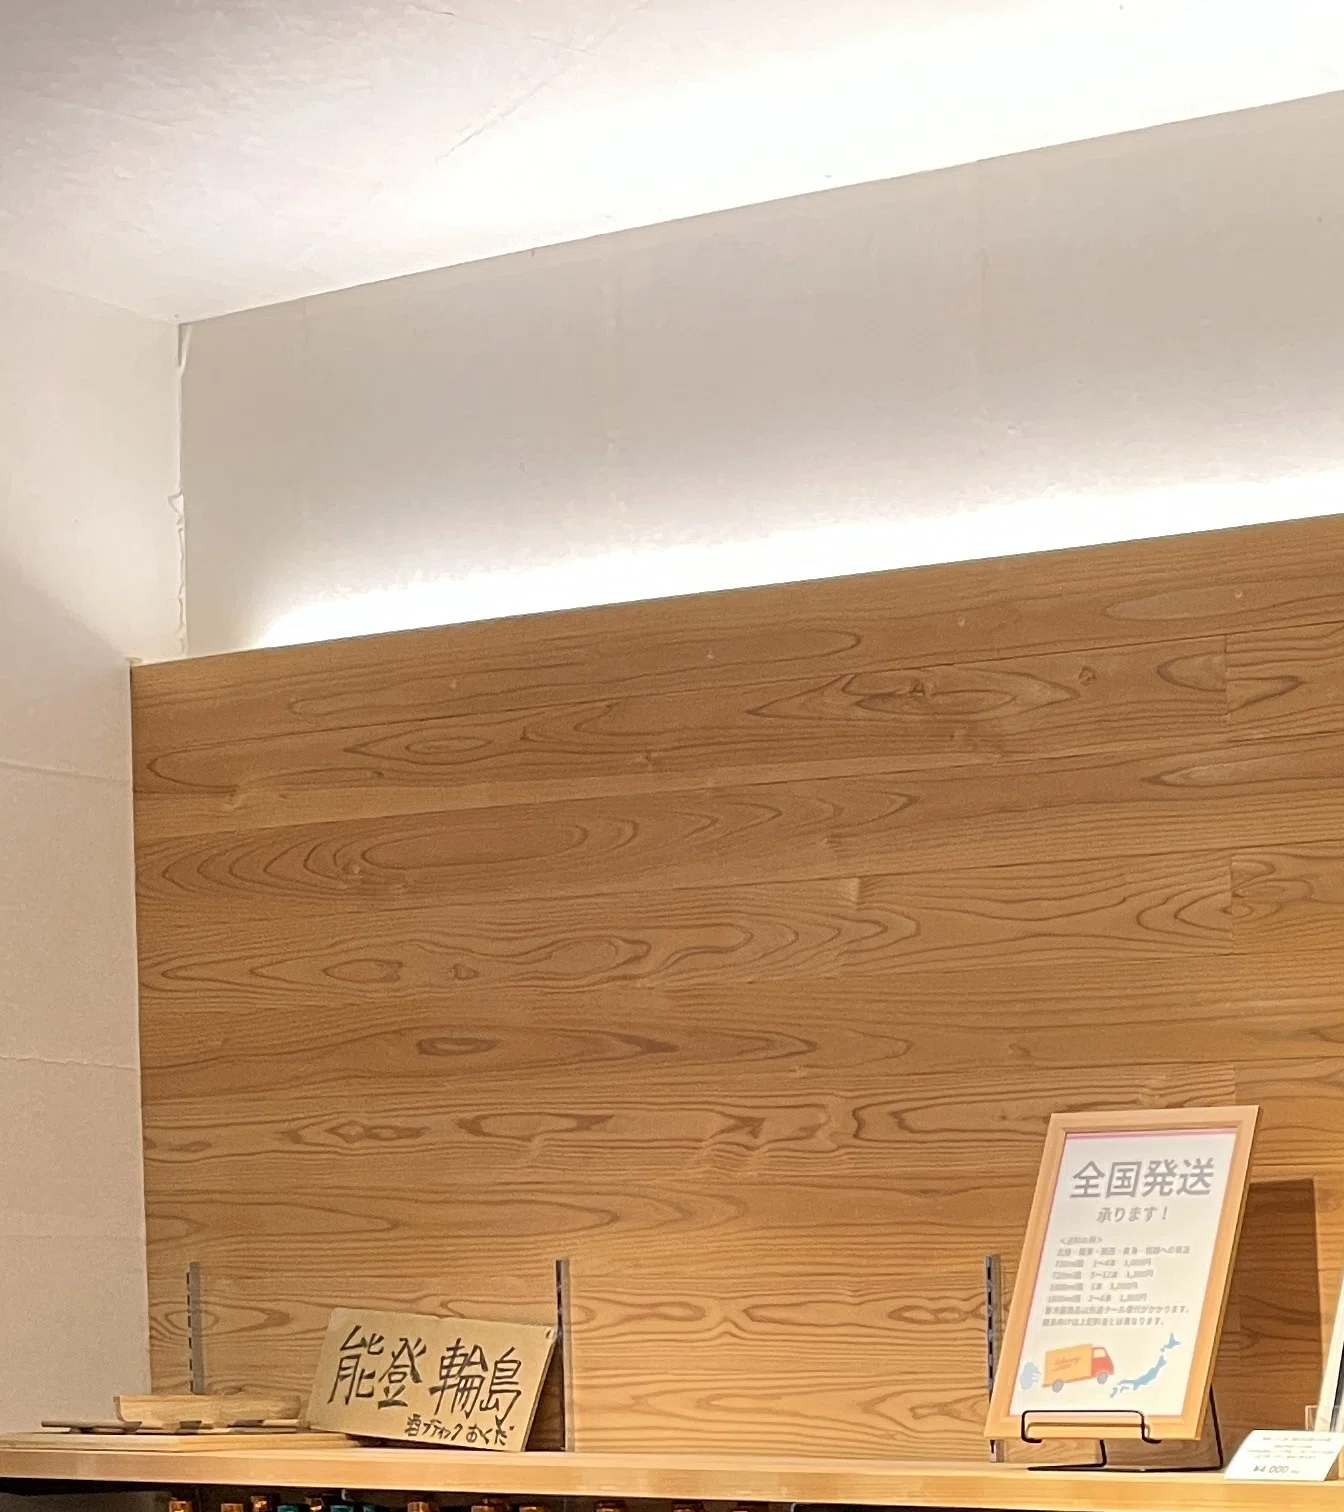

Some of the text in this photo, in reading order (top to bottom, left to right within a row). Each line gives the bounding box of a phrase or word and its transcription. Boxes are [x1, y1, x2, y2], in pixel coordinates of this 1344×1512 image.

[1070, 1157, 1214, 1200] 全国発送
[328, 1325, 521, 1420] 能登 輪島
